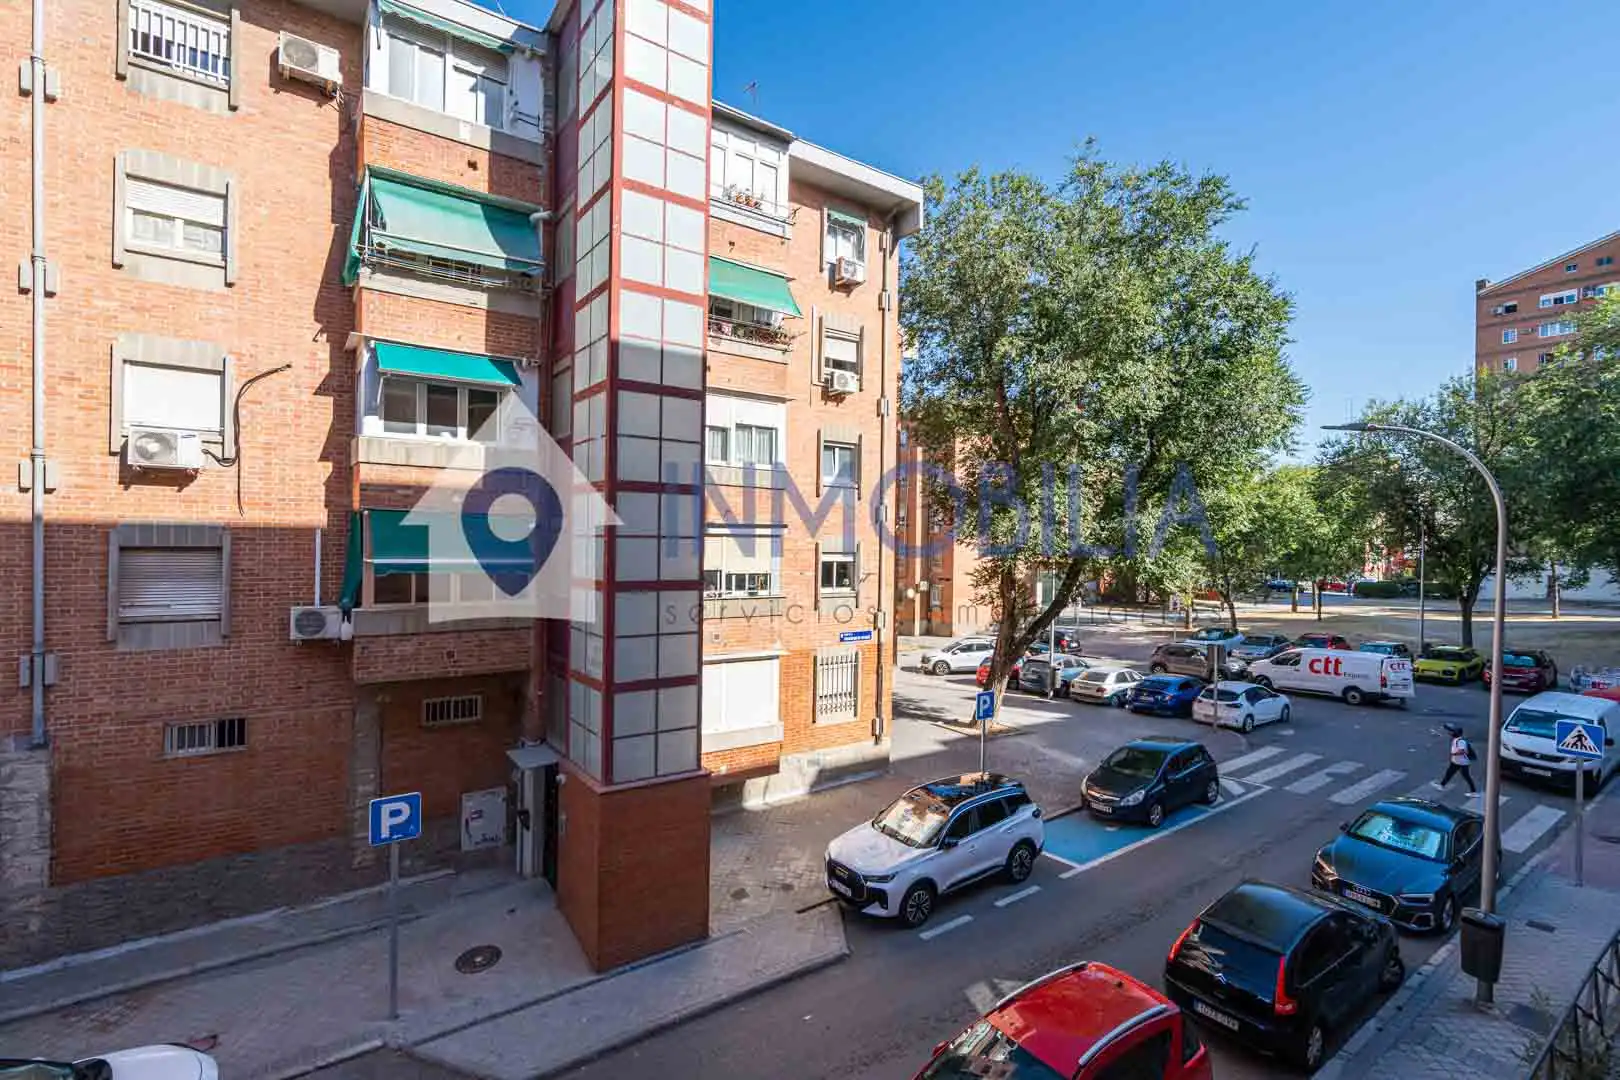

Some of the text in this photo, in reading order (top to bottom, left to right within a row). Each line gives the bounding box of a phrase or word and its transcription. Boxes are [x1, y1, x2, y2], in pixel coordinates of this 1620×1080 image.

[1308, 656, 1343, 676] ctt
[980, 695, 991, 717] P
[381, 802, 410, 839] P
